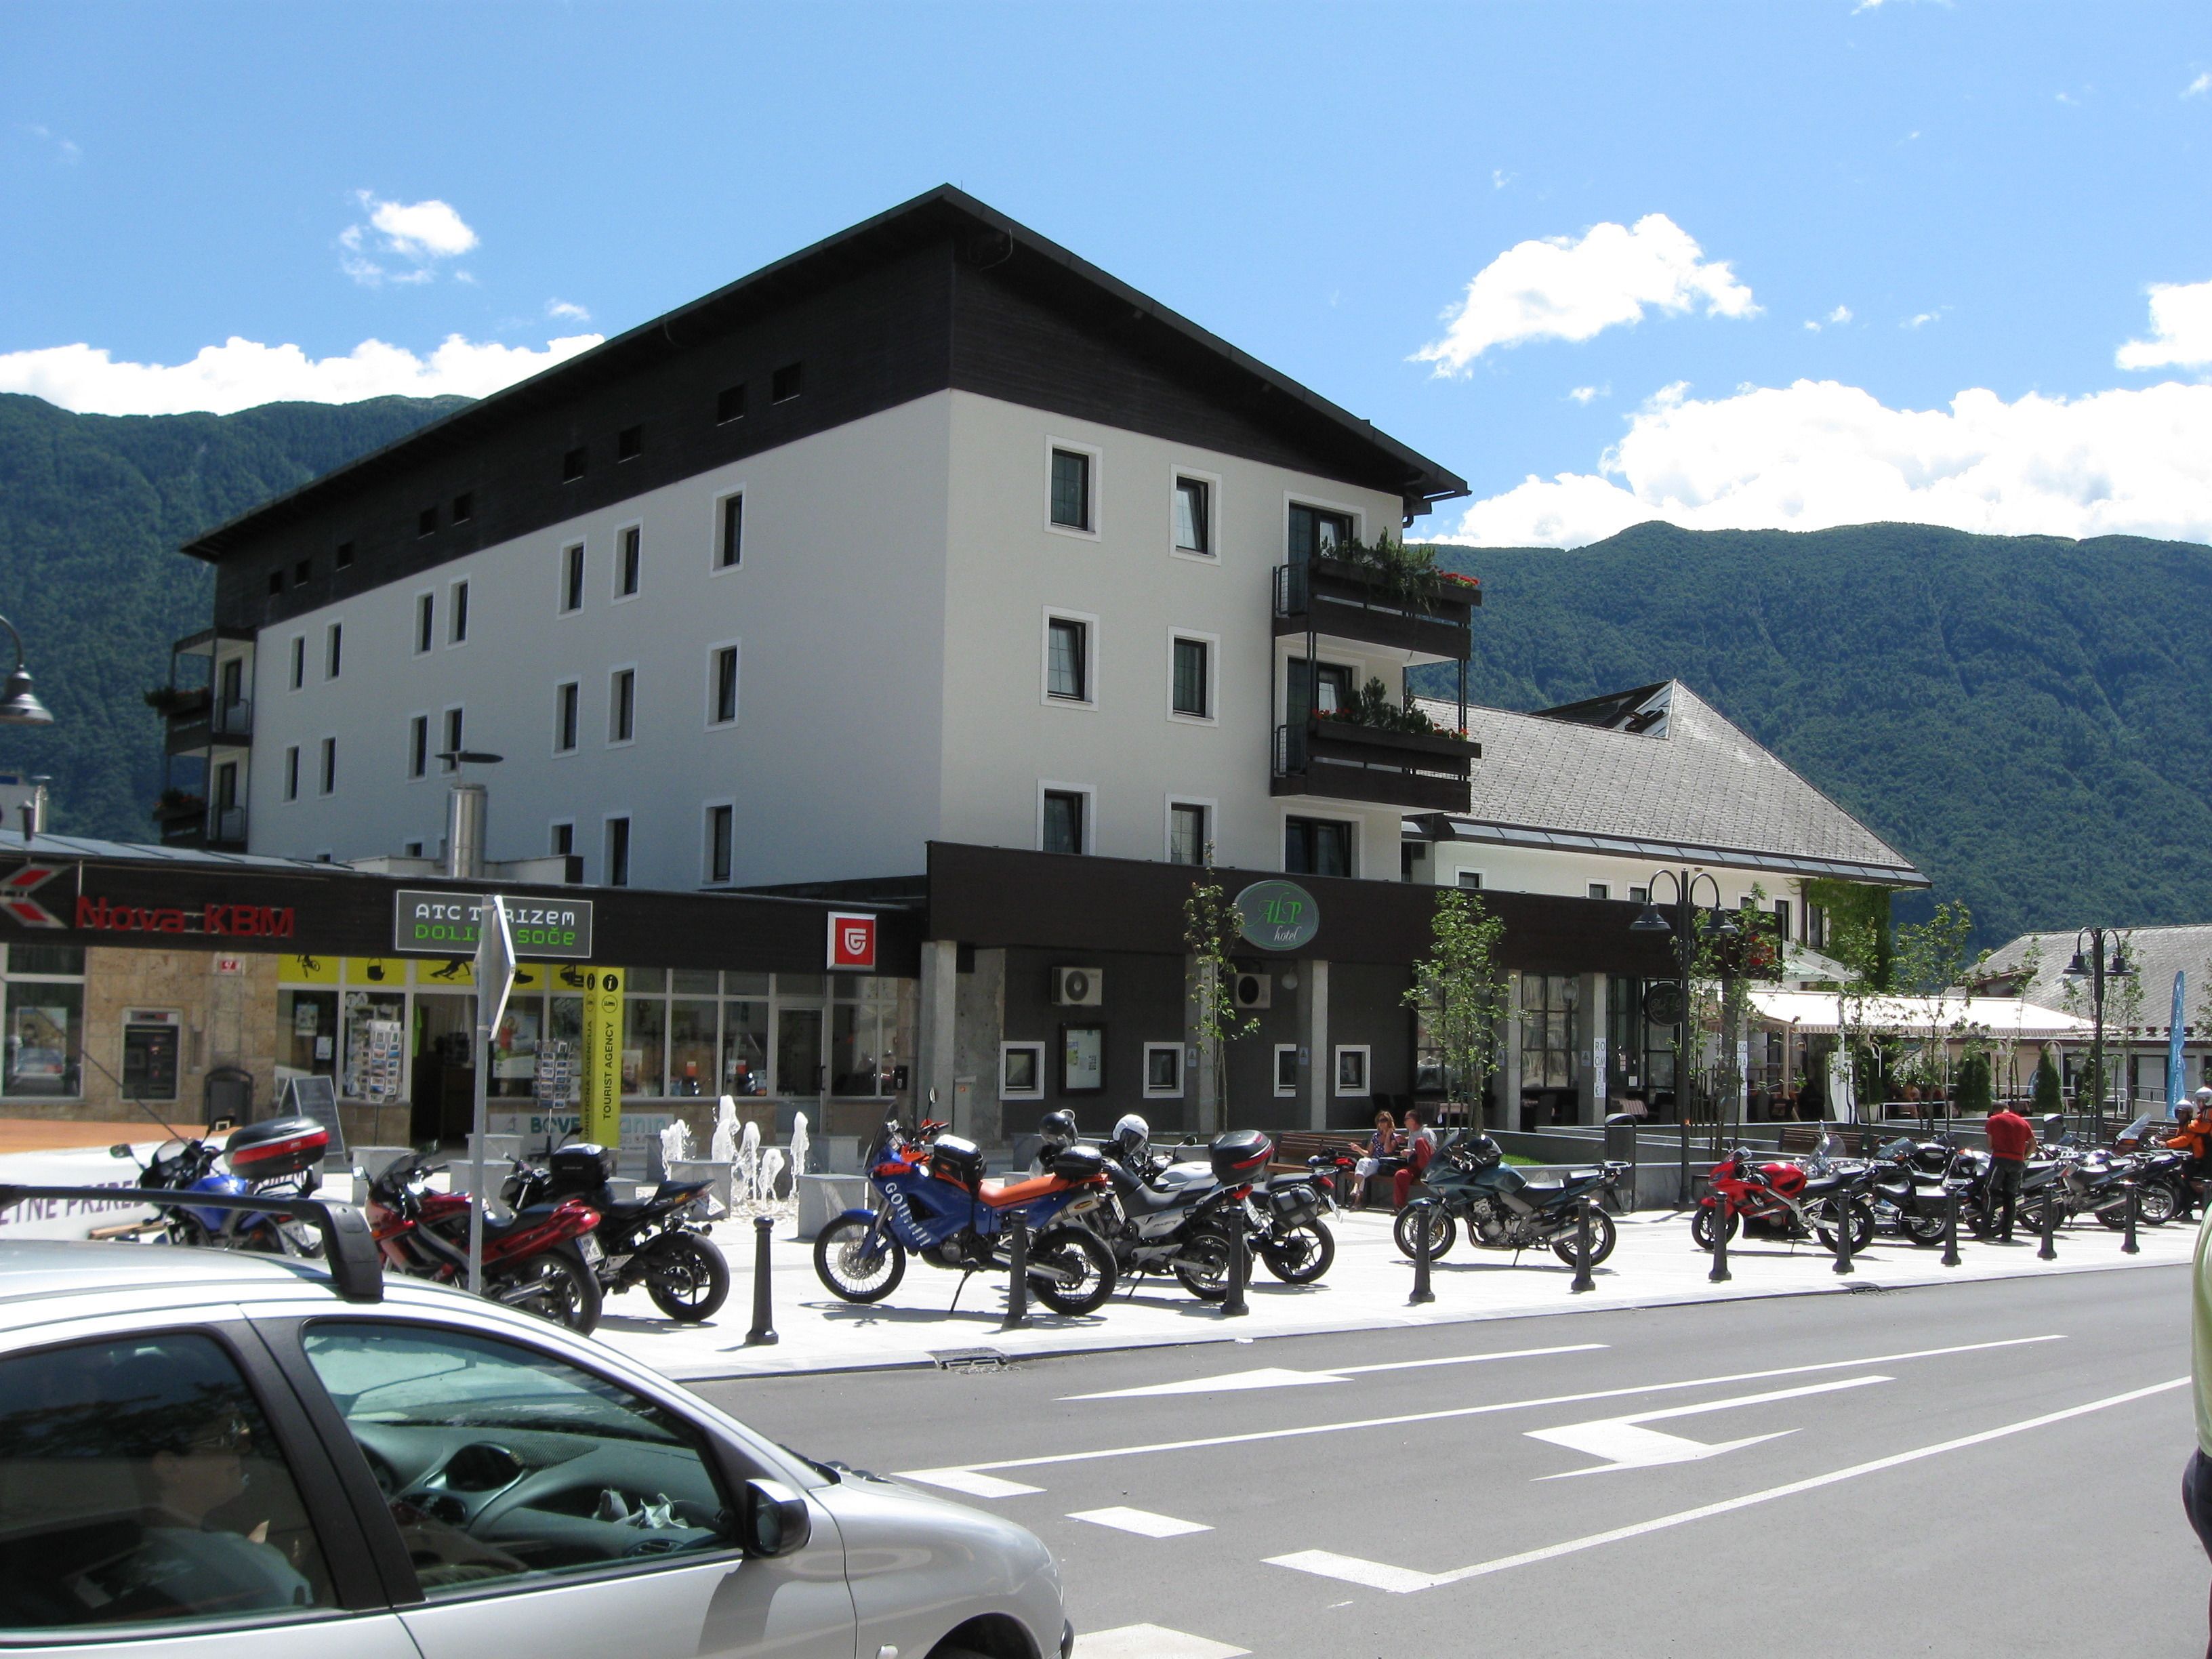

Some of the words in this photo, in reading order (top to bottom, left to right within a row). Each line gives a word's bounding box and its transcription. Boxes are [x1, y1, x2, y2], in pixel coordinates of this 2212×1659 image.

[75, 895, 185, 933] Nova
[204, 903, 295, 938] KBM
[415, 903, 462, 920] ATC
[1248, 892, 1304, 926] ALP
[1274, 925, 1302, 942] hotel
[605, 1022, 614, 1069] AGENCY
[584, 1082, 593, 1141] URISTIČNA
[602, 1072, 613, 1120] TOURIST
[530, 1115, 583, 1134] BOVE
